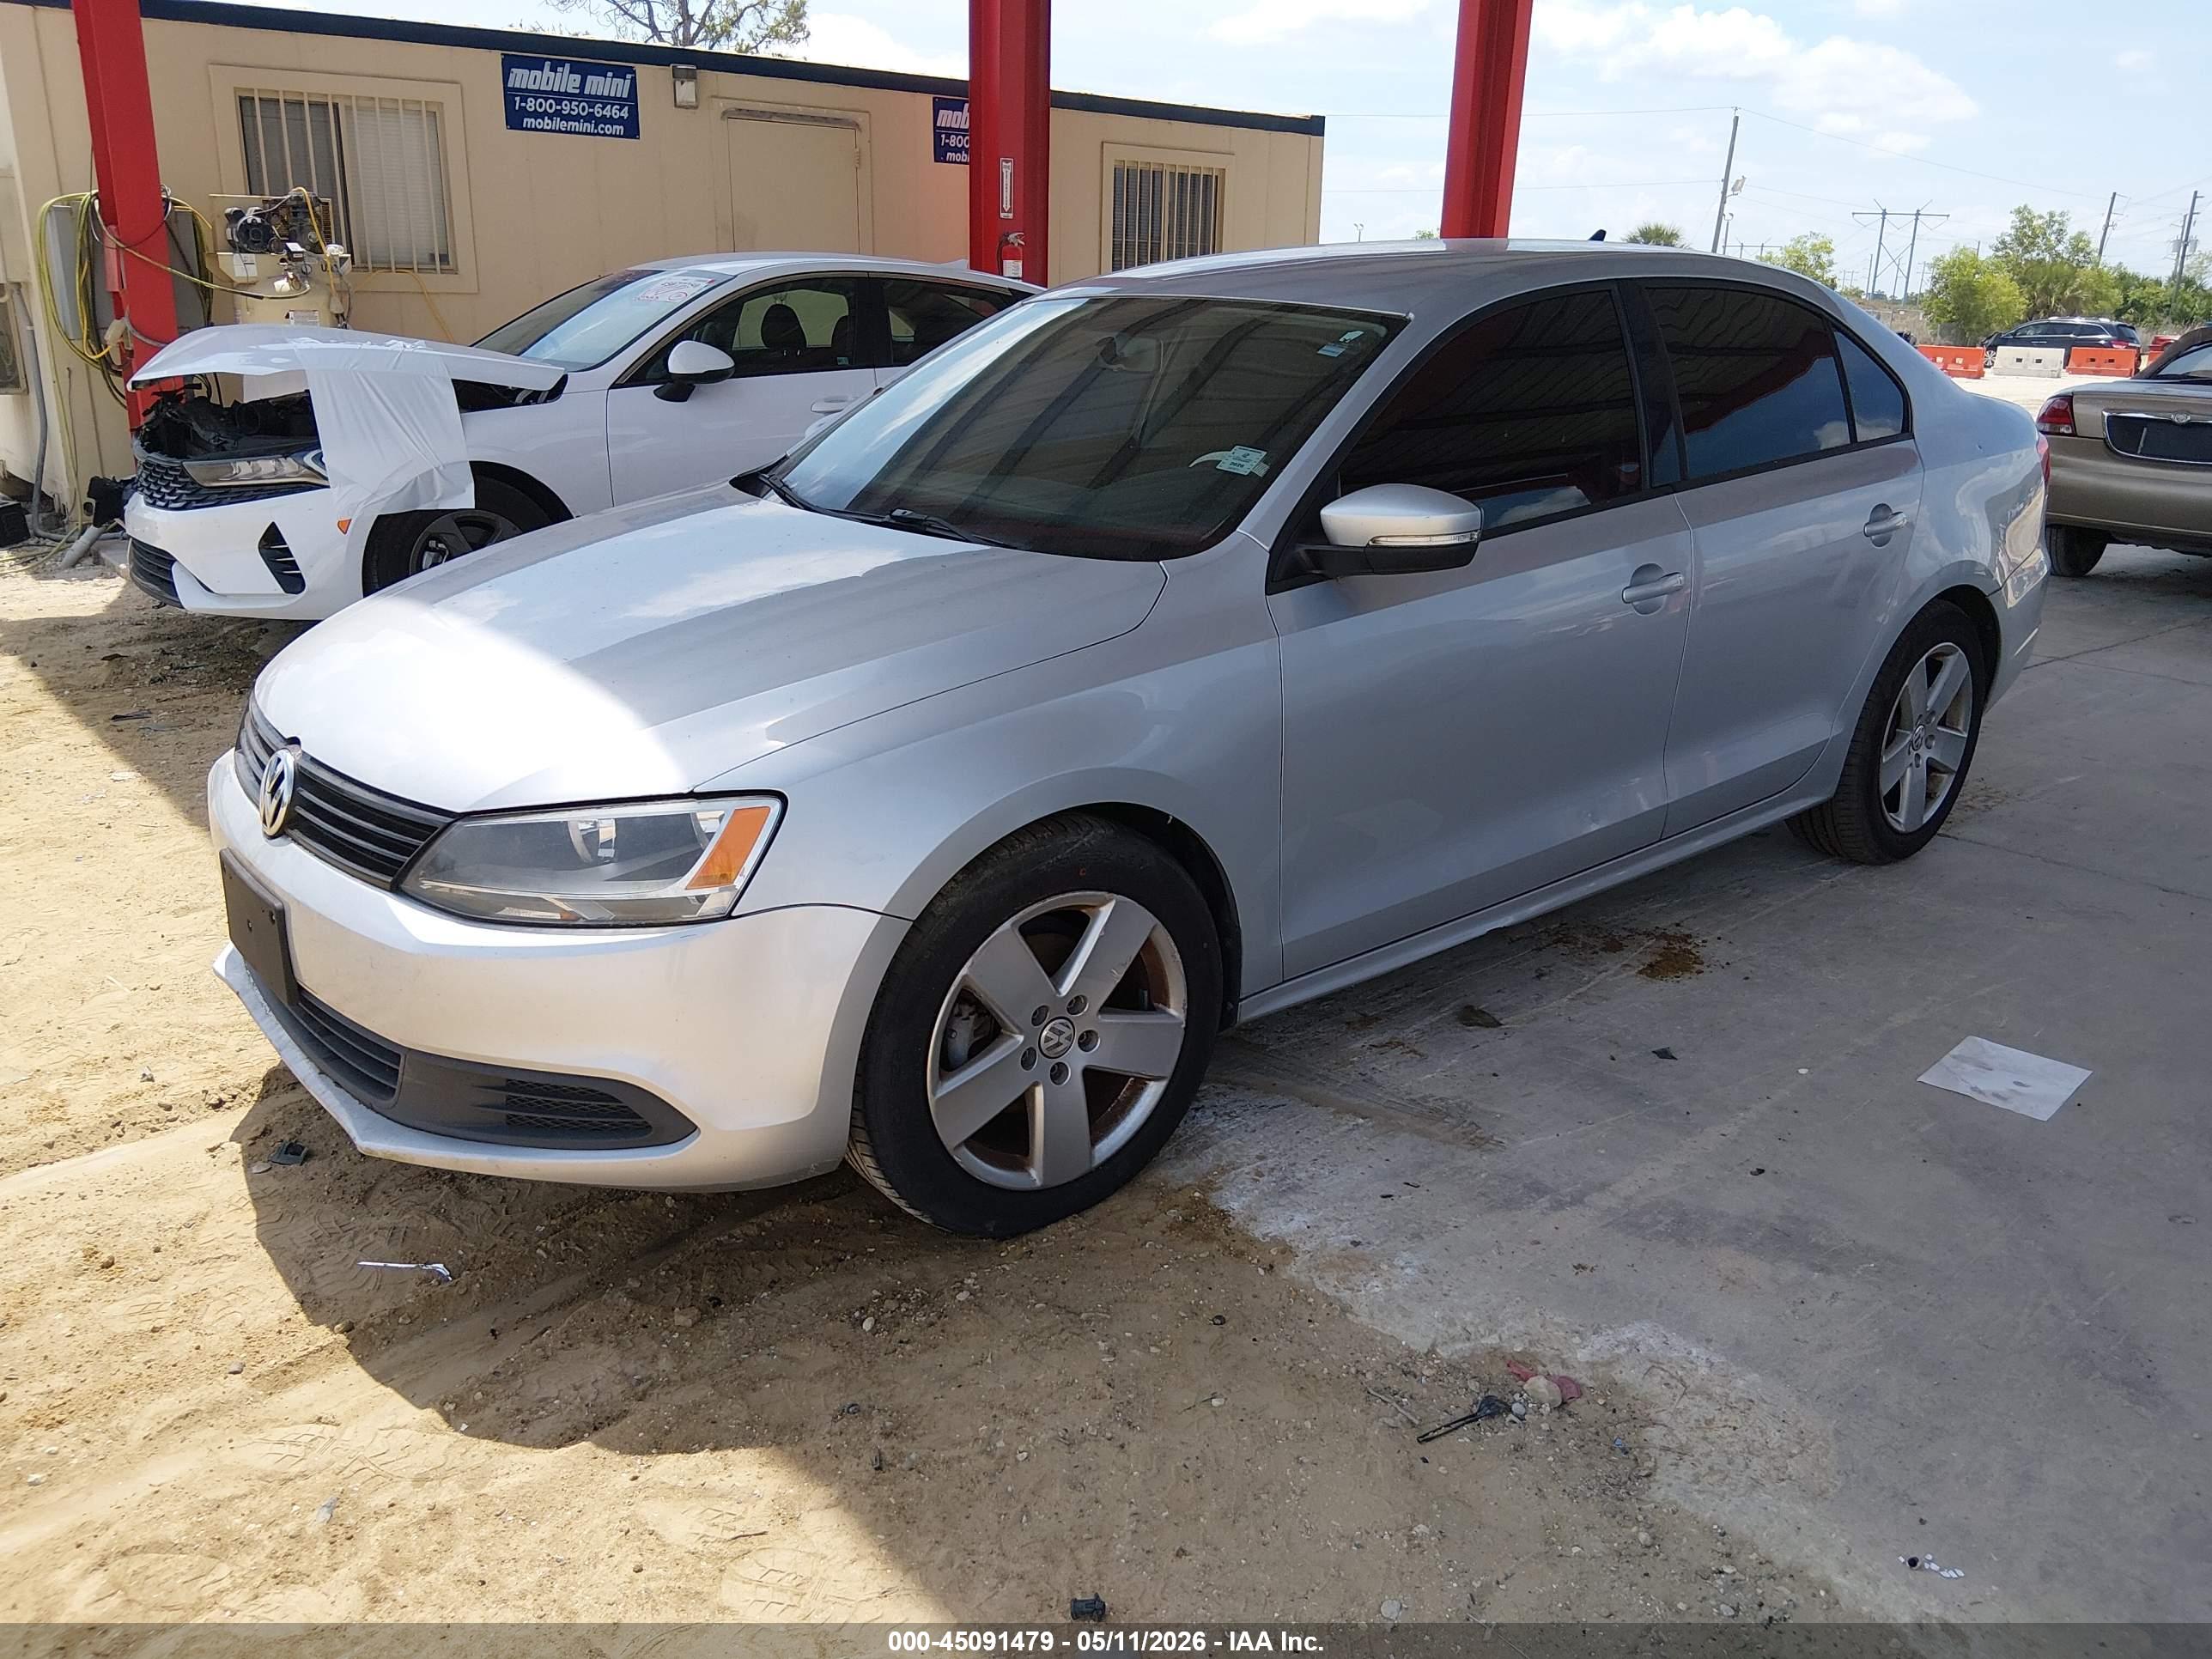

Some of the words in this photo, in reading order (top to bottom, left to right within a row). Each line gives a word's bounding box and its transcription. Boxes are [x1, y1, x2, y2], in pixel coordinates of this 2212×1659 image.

[507, 61, 581, 94] mobile
[584, 71, 632, 98] mini
[514, 96, 629, 119] 1-800-950-6464
[523, 117, 624, 136] mobilemini.com
